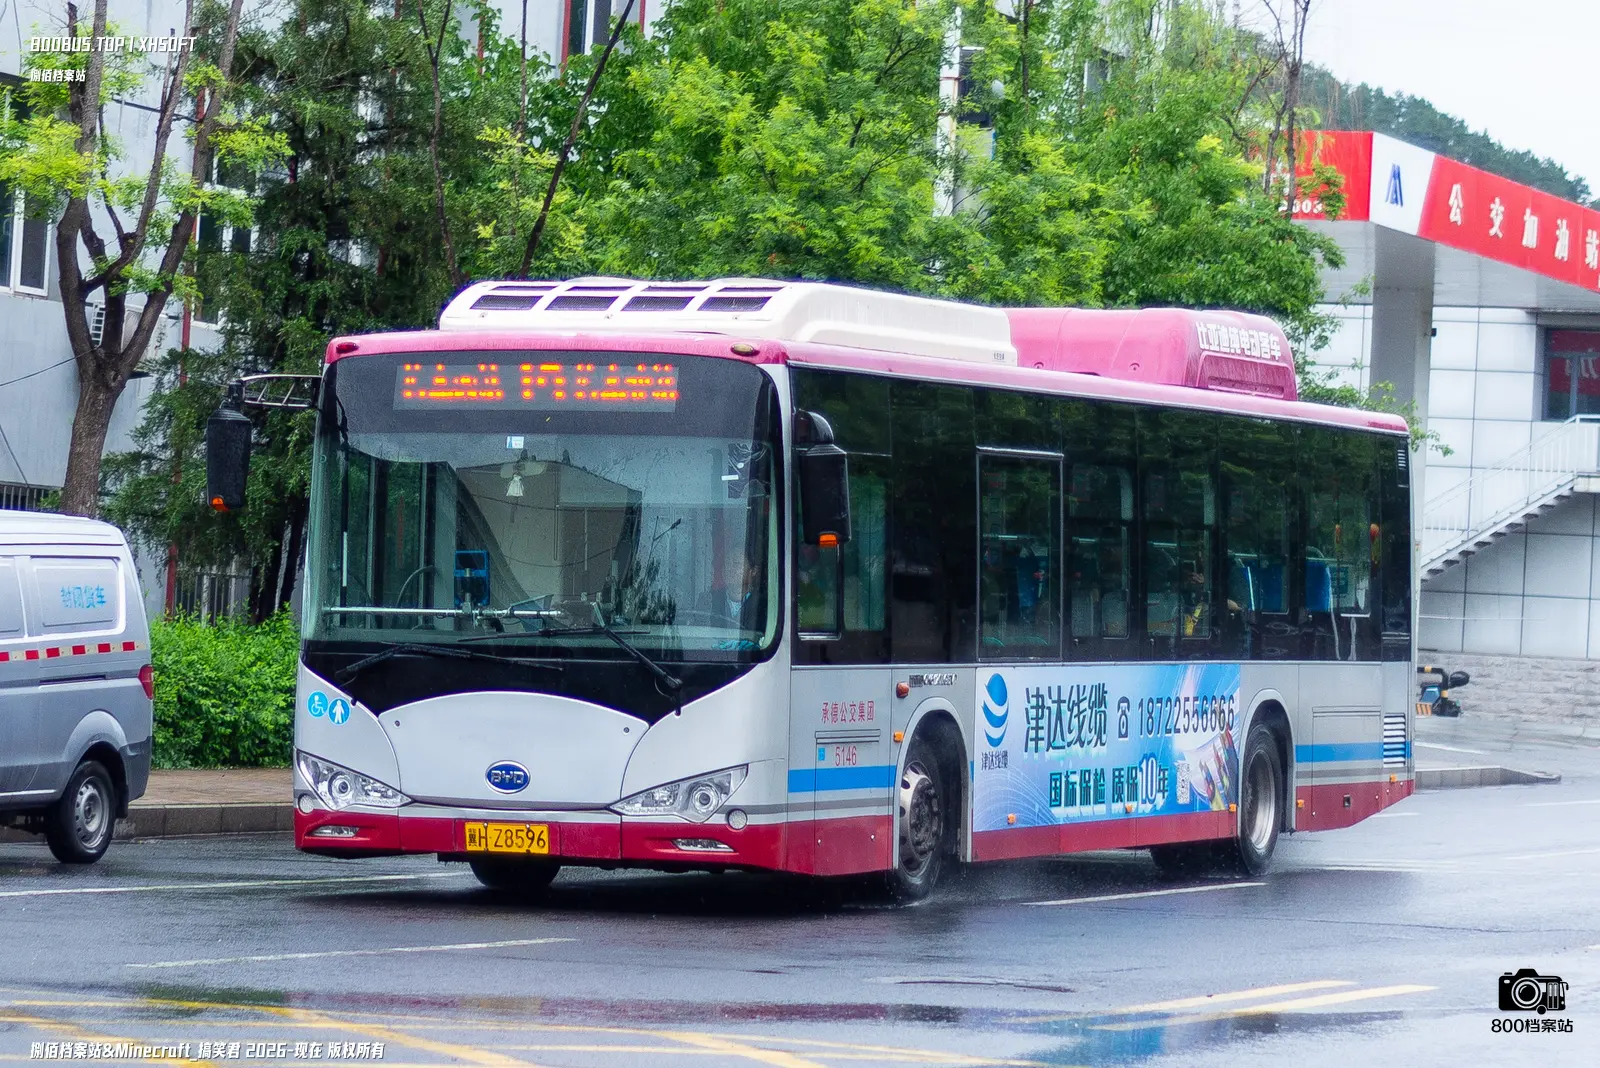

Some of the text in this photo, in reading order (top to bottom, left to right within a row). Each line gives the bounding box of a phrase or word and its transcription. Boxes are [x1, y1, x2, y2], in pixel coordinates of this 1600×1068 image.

[821, 701, 875, 723] 承德公交集团
[1024, 683, 1108, 753] 津达线缆
[1138, 694, 1235, 736] 18722556666
[835, 746, 857, 766] 5146
[491, 770, 525, 784] BYD
